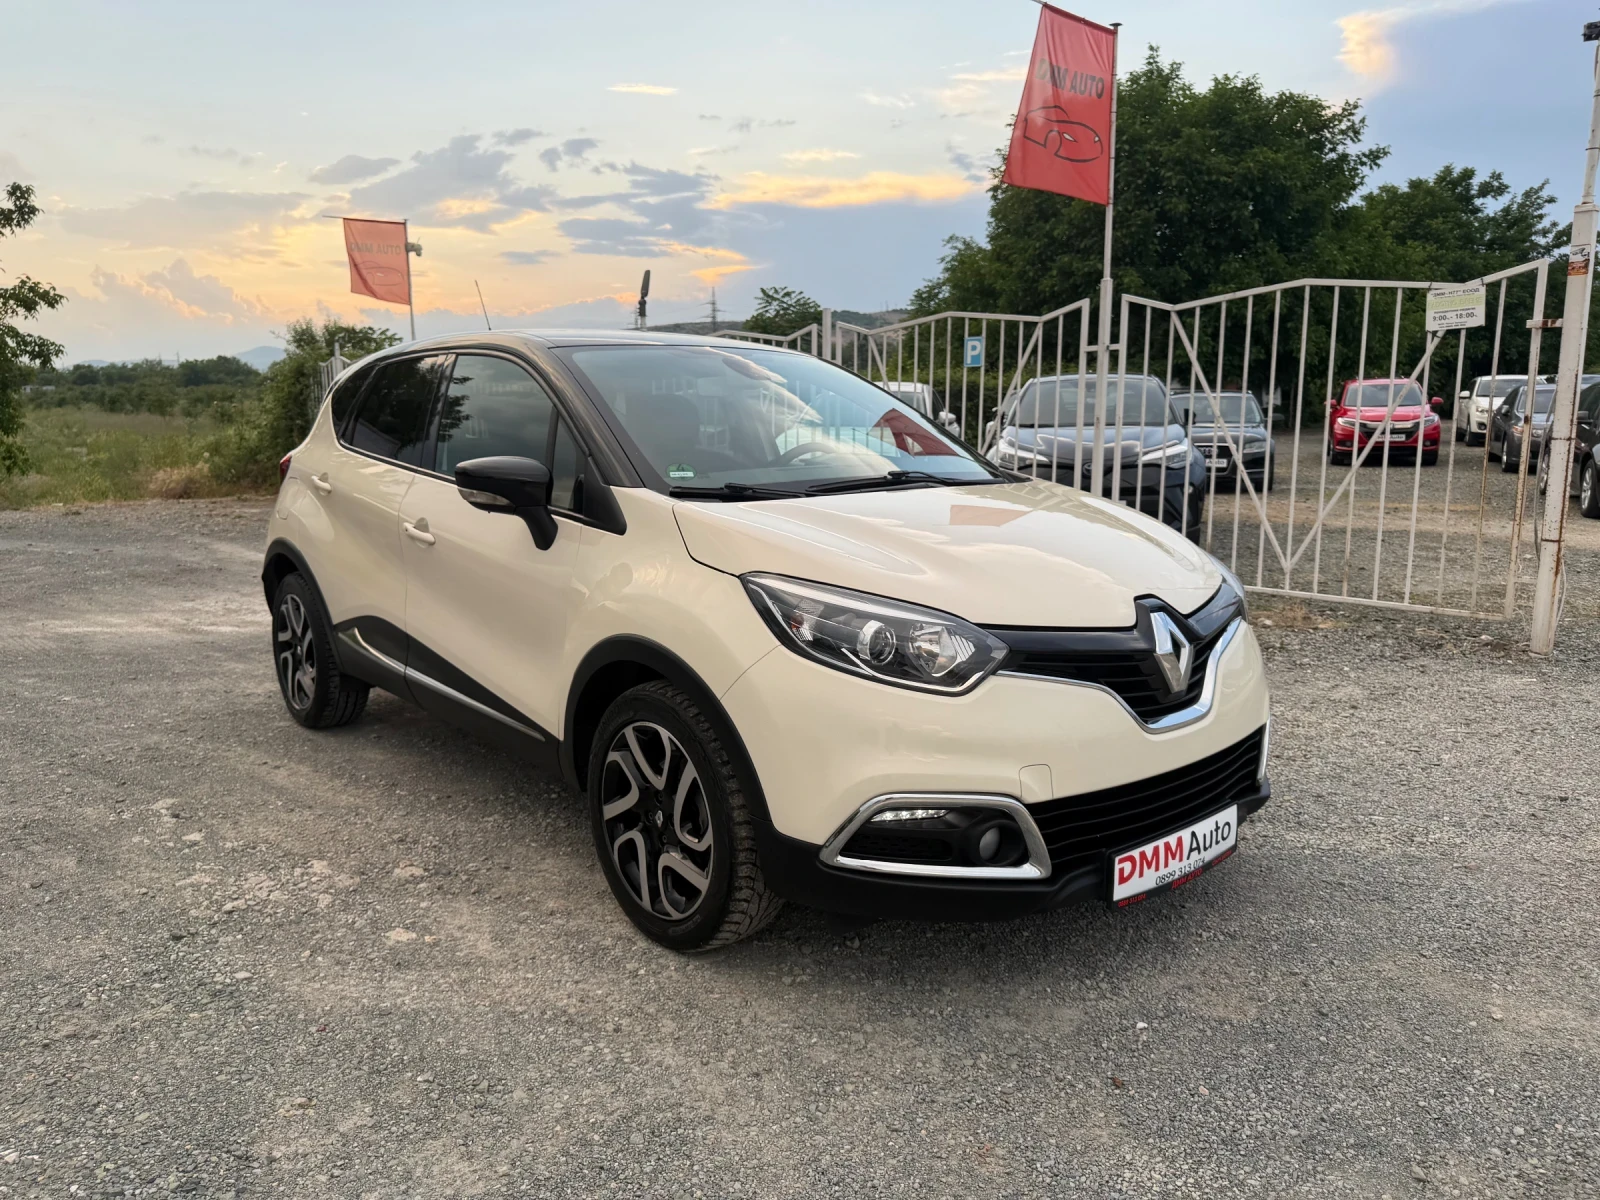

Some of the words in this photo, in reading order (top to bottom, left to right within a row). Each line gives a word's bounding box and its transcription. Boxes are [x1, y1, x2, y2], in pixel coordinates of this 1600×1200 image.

[1069, 71, 1104, 99] AUTO
[377, 244, 401, 255] AUTO
[967, 341, 981, 364] P
[1117, 835, 1184, 886] DMM
[1186, 820, 1231, 861] Auto
[1155, 870, 1177, 886] 0899
[1177, 864, 1192, 878] 313
